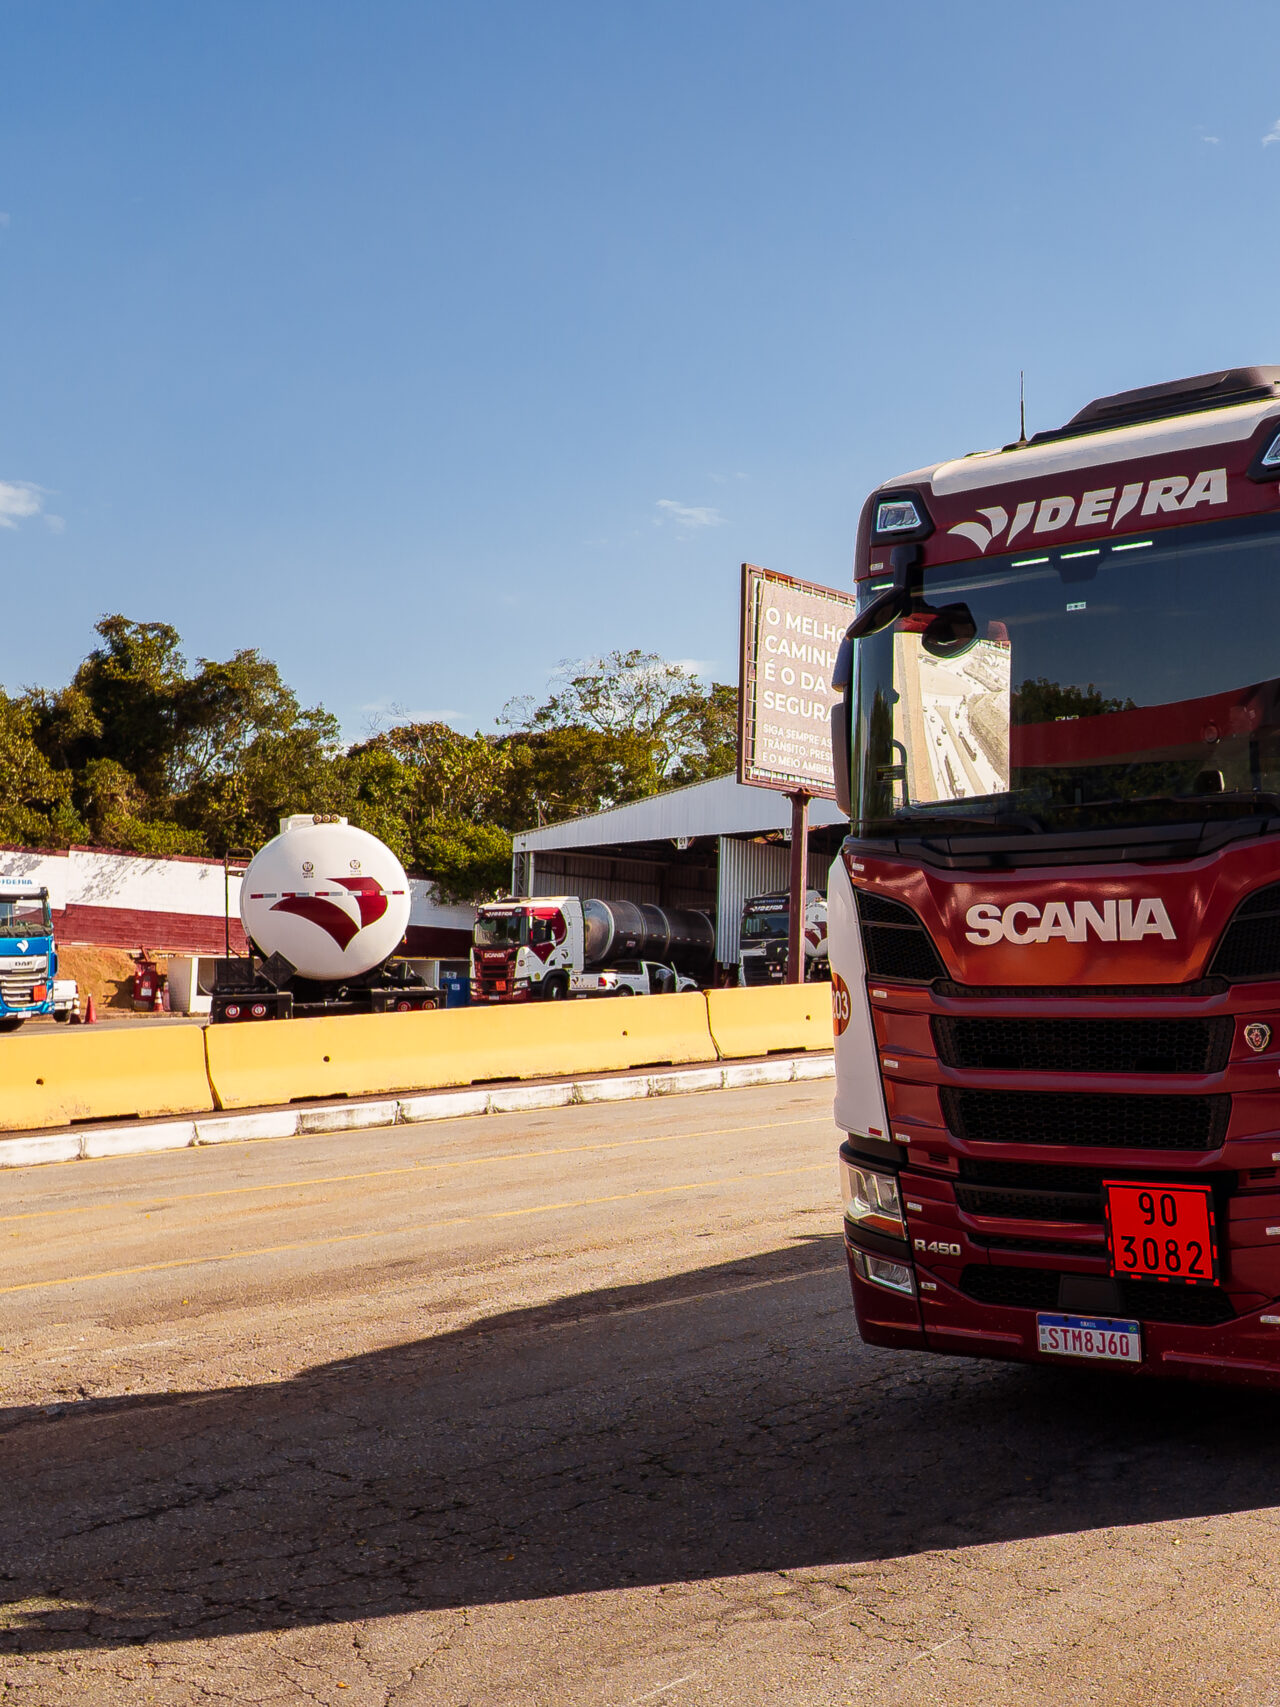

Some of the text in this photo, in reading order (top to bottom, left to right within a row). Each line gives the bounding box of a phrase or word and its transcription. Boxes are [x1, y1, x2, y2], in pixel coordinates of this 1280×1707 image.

[765, 607, 848, 643] O MELHO
[764, 634, 838, 669] CAMINH
[764, 658, 828, 695] É O DA
[762, 723, 785, 737] SIGA
[785, 728, 820, 746] SEMPRE
[762, 752, 768, 762] E
[769, 753, 777, 764] O
[778, 755, 801, 769] MEIO
[965, 898, 1177, 946] SCANIA
[1138, 1192, 1177, 1227] 90
[1121, 1235, 1204, 1275] 3082
[1048, 1328, 1130, 1357] STM8J60
